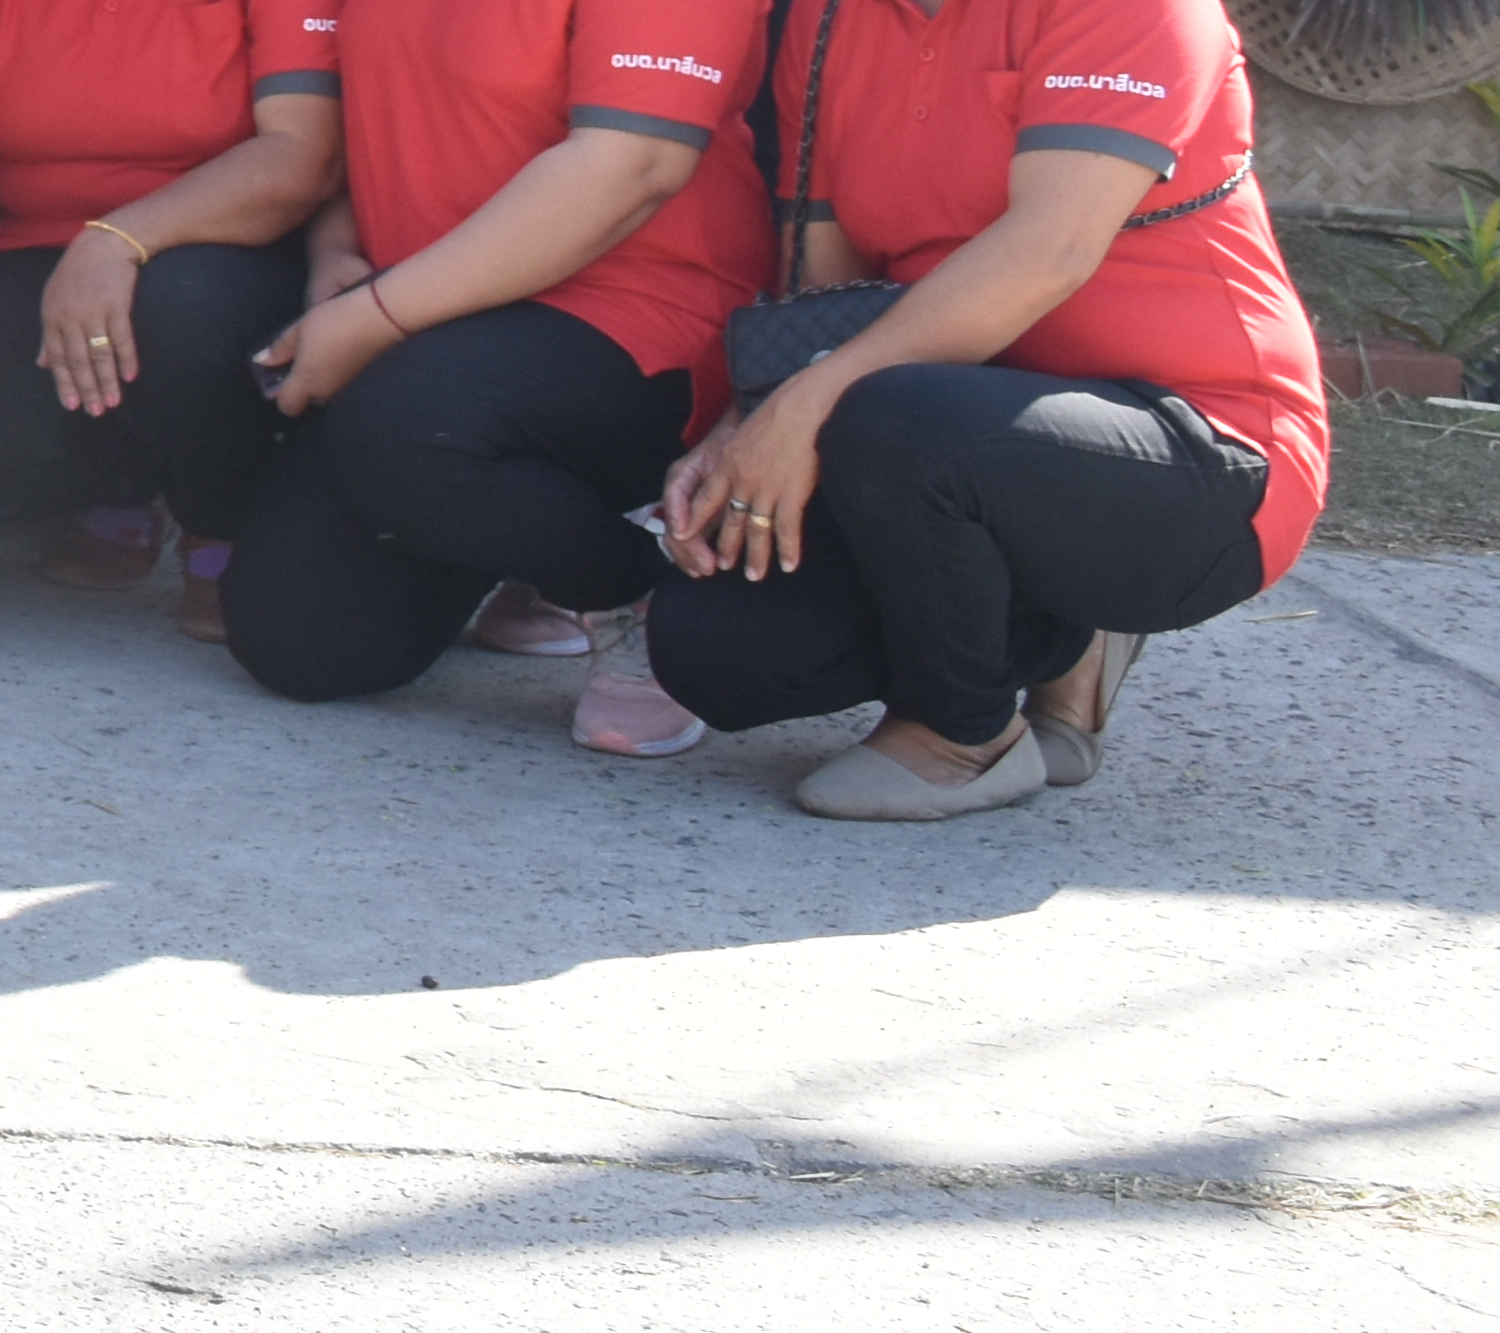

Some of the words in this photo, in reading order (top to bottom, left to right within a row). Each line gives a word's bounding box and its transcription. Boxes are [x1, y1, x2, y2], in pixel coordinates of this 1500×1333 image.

[611, 53, 723, 85] อบต.นาสีนวล
[1043, 71, 1167, 100] อบต.นาสีนวล
